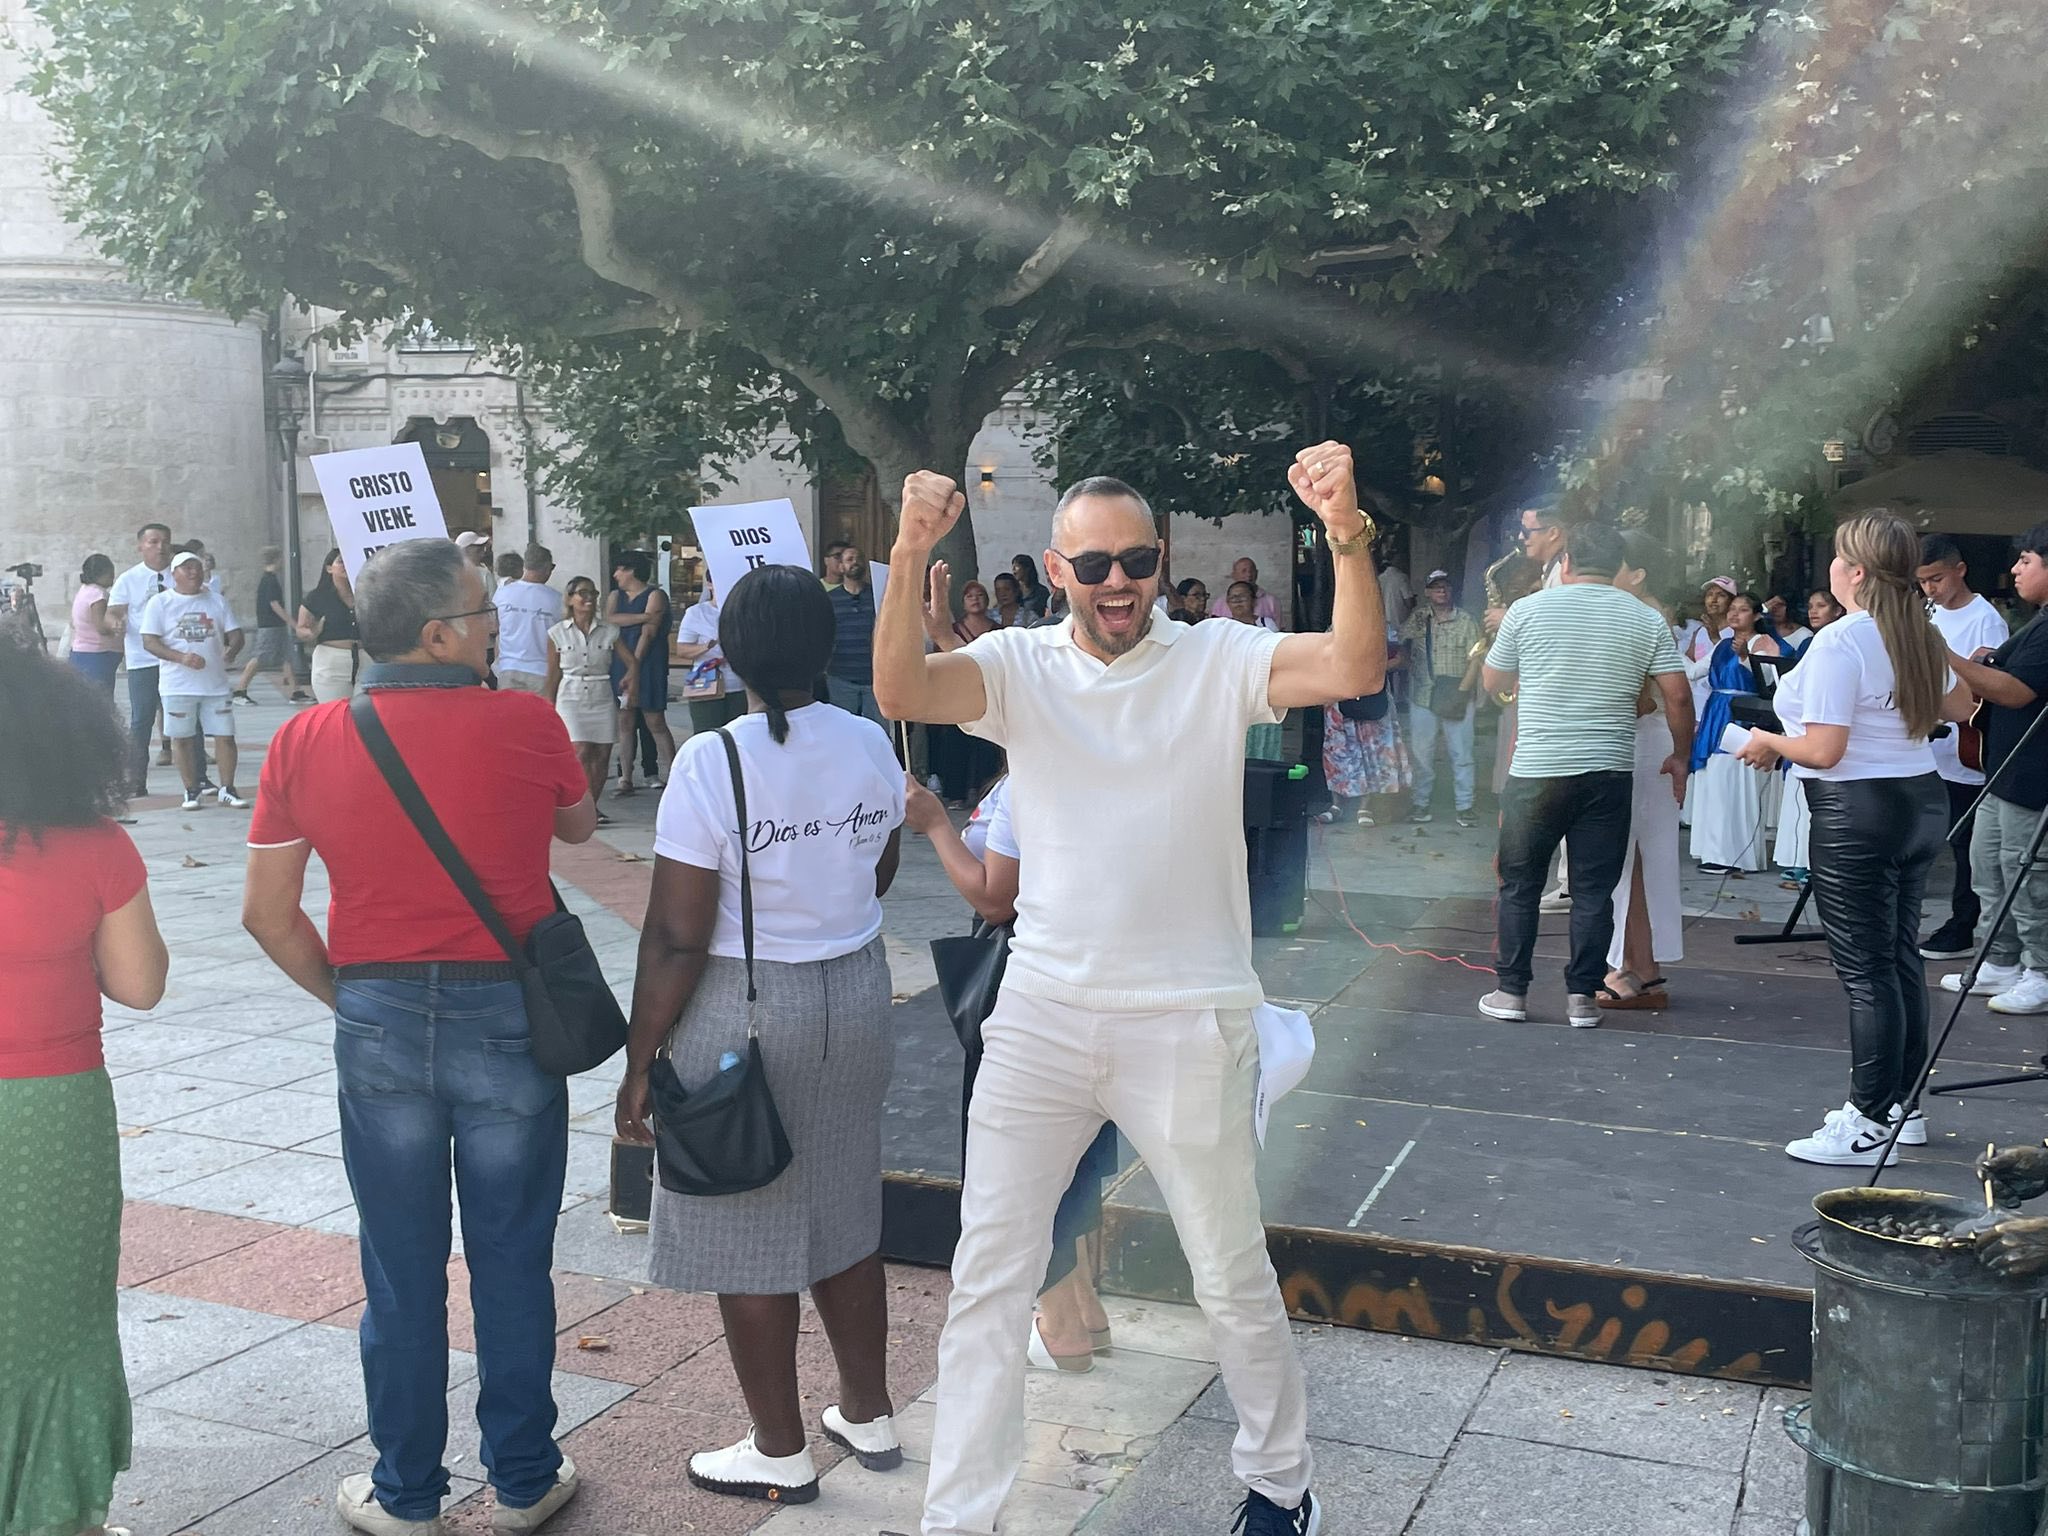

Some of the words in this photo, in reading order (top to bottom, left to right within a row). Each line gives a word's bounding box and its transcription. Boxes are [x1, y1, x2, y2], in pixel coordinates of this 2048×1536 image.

[349, 471, 413, 499] CRISTO
[362, 505, 416, 533] VIENE
[729, 527, 771, 547] DIOS
[745, 555, 766, 570] TE
[740, 818, 799, 853] Dios
[804, 820, 822, 837] es
[827, 802, 888, 837] Amor
